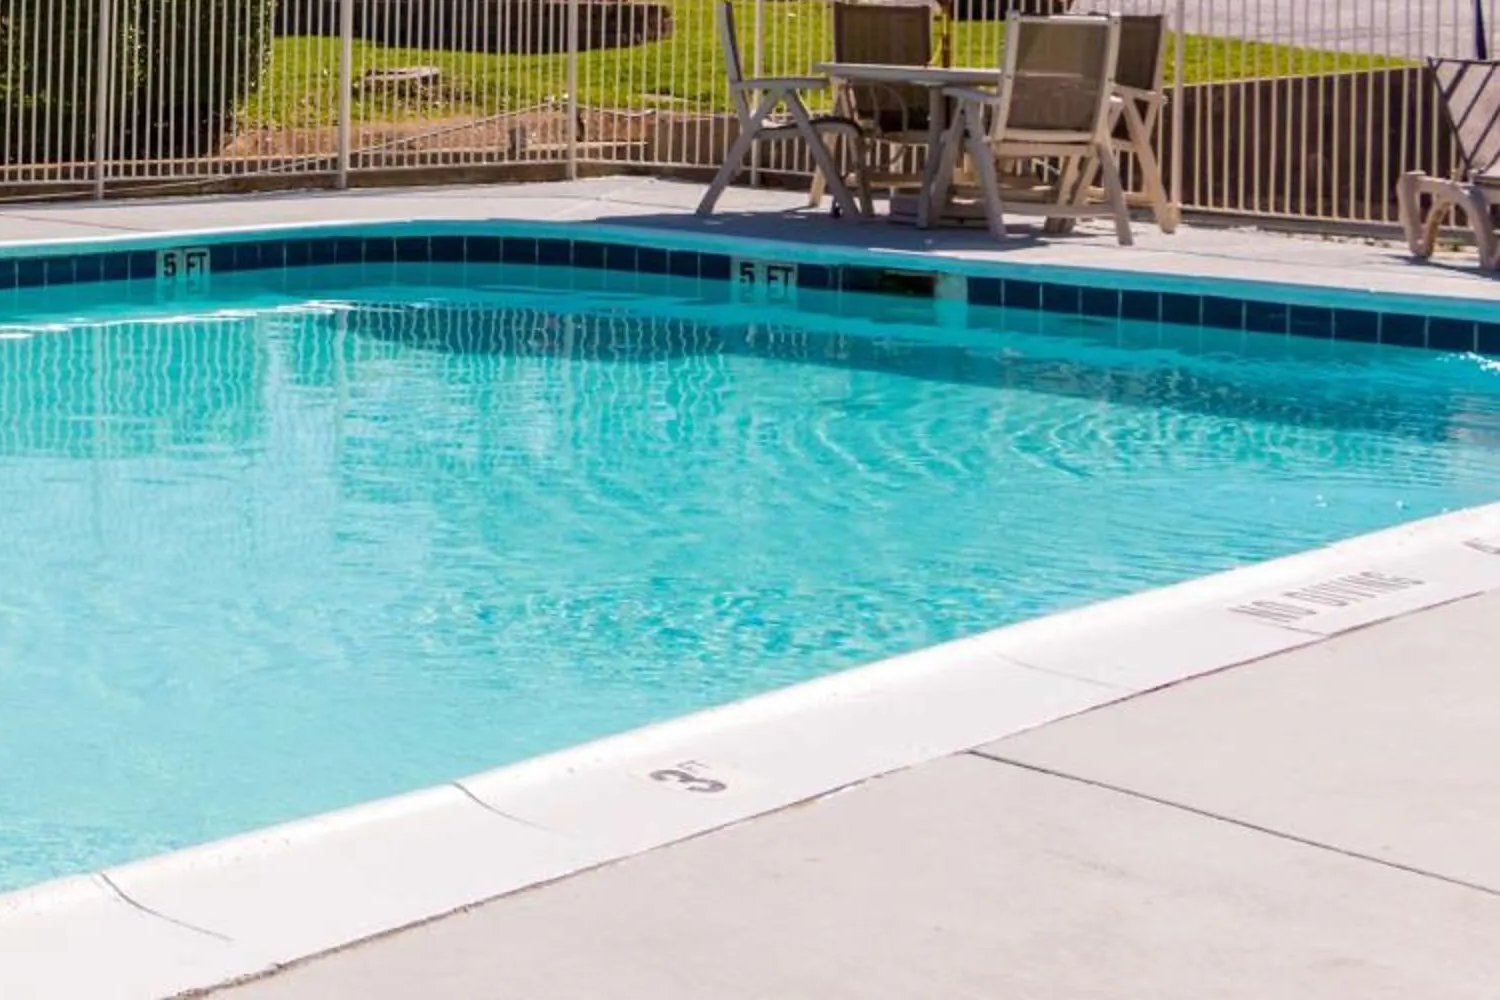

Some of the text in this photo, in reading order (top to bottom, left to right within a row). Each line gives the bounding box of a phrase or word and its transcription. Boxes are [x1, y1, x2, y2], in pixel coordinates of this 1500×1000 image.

[163, 251, 207, 277] 5 FT
[739, 261, 795, 288] 5 FT
[1227, 571, 1426, 623] NO DIVING
[648, 768, 727, 793] 3
